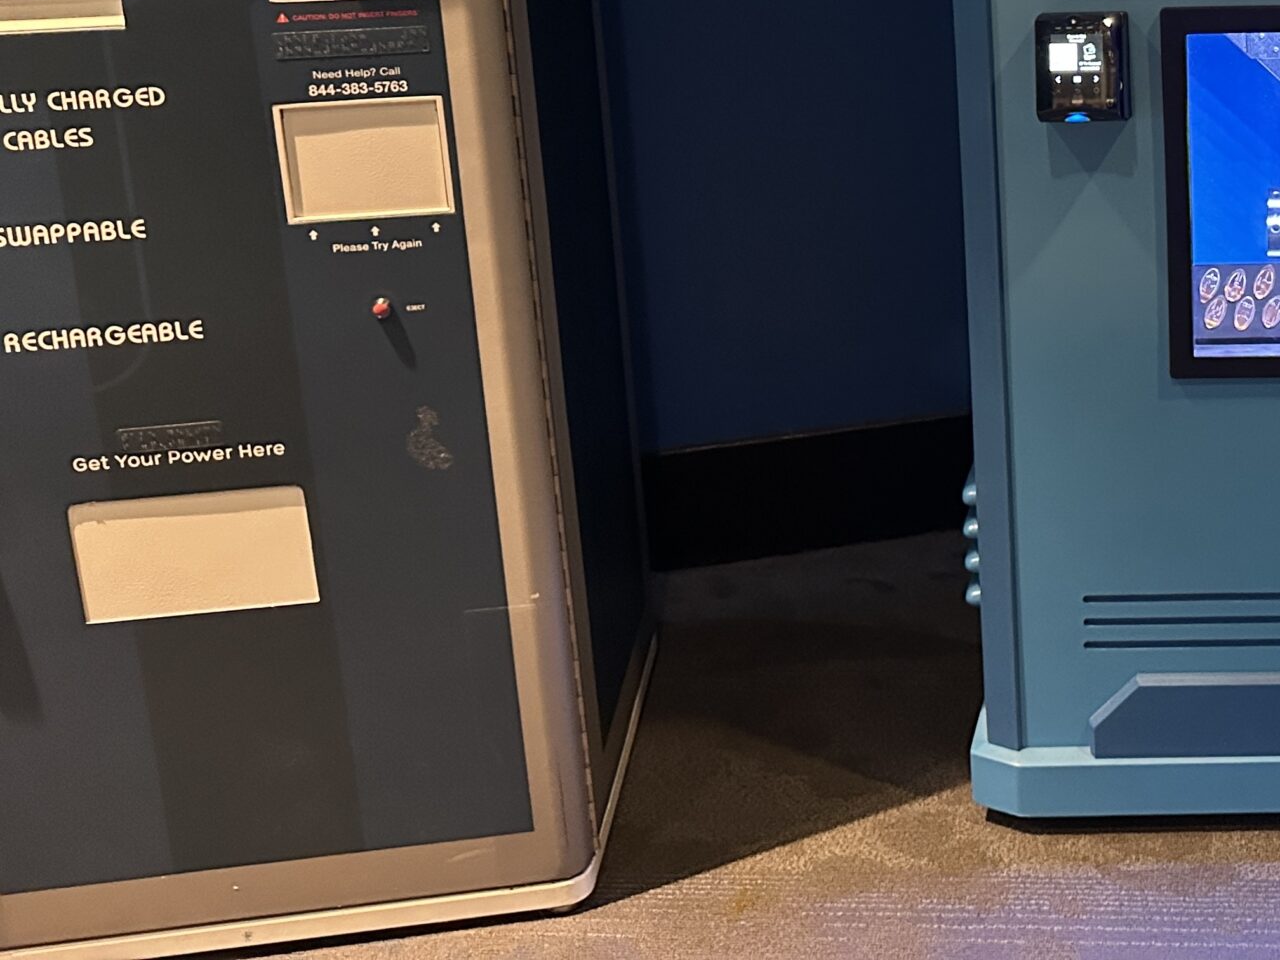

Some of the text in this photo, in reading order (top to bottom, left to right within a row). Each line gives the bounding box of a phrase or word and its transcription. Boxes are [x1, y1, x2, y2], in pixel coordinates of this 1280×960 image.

[312, 67, 401, 79] Need Help? Call
[47, 86, 166, 111] CHARGED
[308, 80, 408, 96] 844-383-5763
[3, 127, 94, 151] CABLES
[332, 239, 422, 253] Please Try Again
[3, 319, 204, 353] RECHARGEABLE
[72, 441, 286, 473] Get Your Power Here
